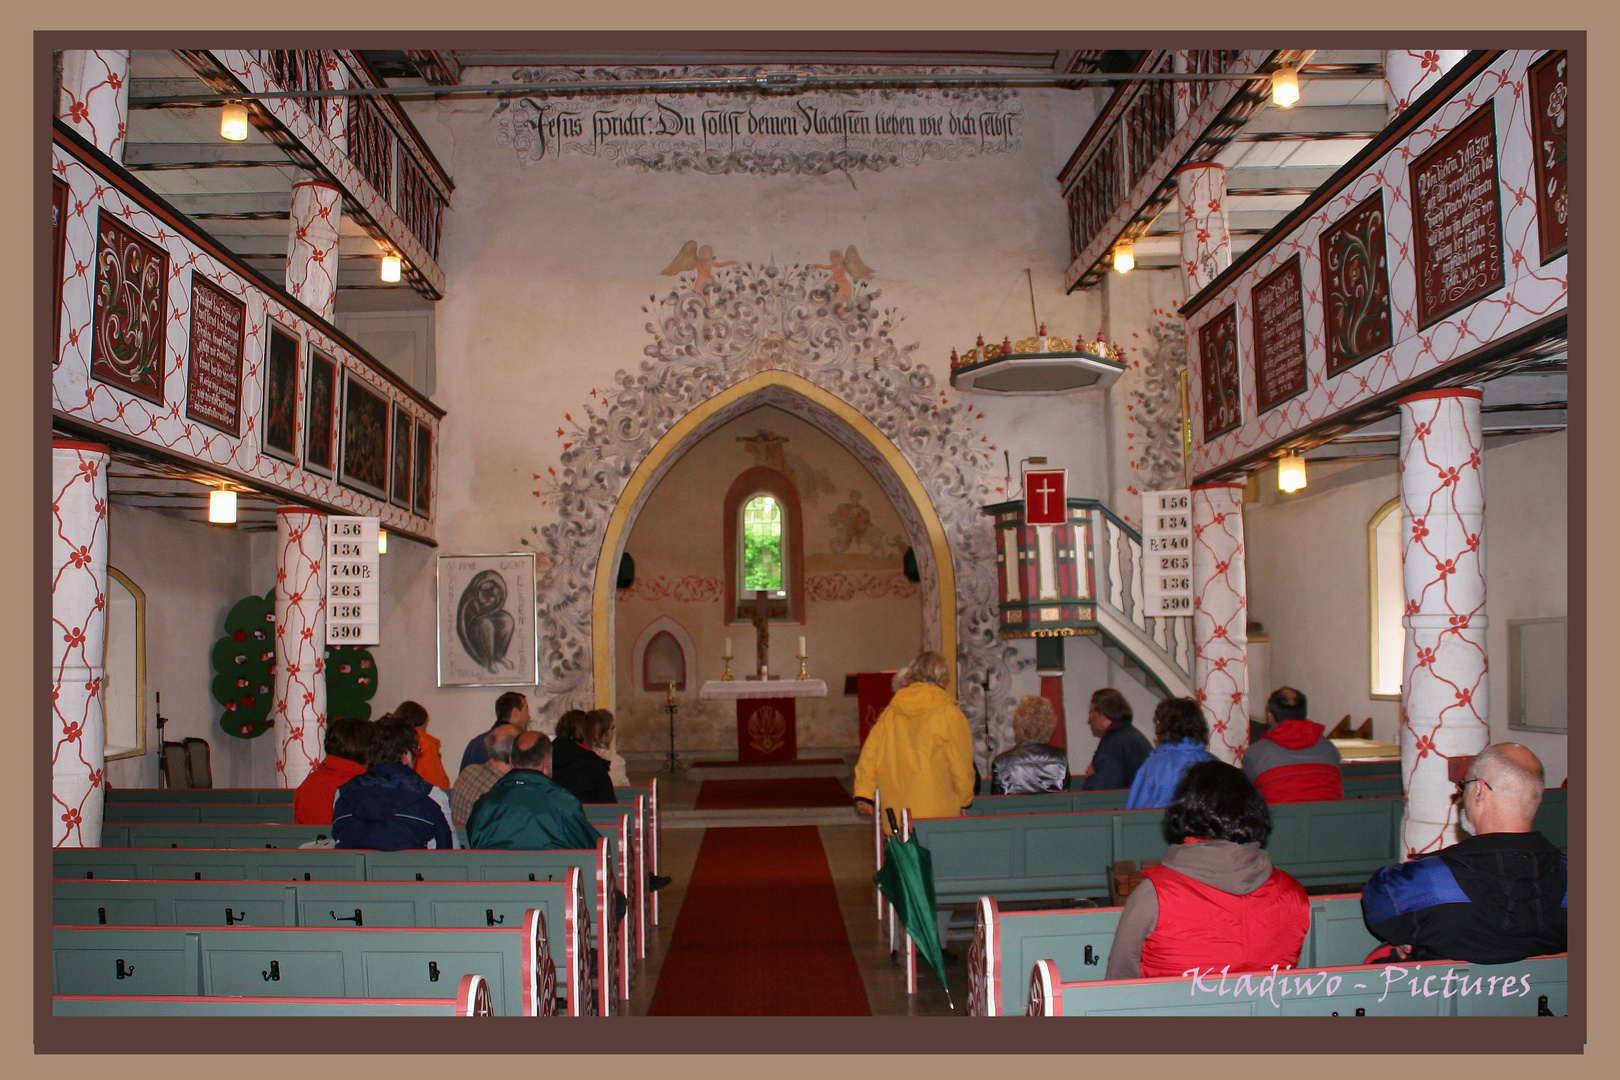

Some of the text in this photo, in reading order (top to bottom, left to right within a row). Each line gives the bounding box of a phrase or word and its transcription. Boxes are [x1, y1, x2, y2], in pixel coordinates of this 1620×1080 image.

[655, 95, 696, 136] Du
[748, 106, 799, 136] deinen
[875, 109, 917, 136] lieben
[919, 113, 944, 137] wie
[949, 109, 977, 136] dich
[1161, 497, 1188, 509] 156
[333, 523, 361, 535] 156
[1159, 517, 1187, 529] 134
[1161, 537, 1189, 549] 740
[333, 544, 360, 555] 134
[1162, 558, 1189, 569] 265
[331, 564, 360, 576] 740
[1163, 578, 1189, 590] 136
[331, 585, 360, 597] 265
[1163, 598, 1190, 610] 590
[332, 606, 360, 617] 136
[331, 626, 360, 638] 590
